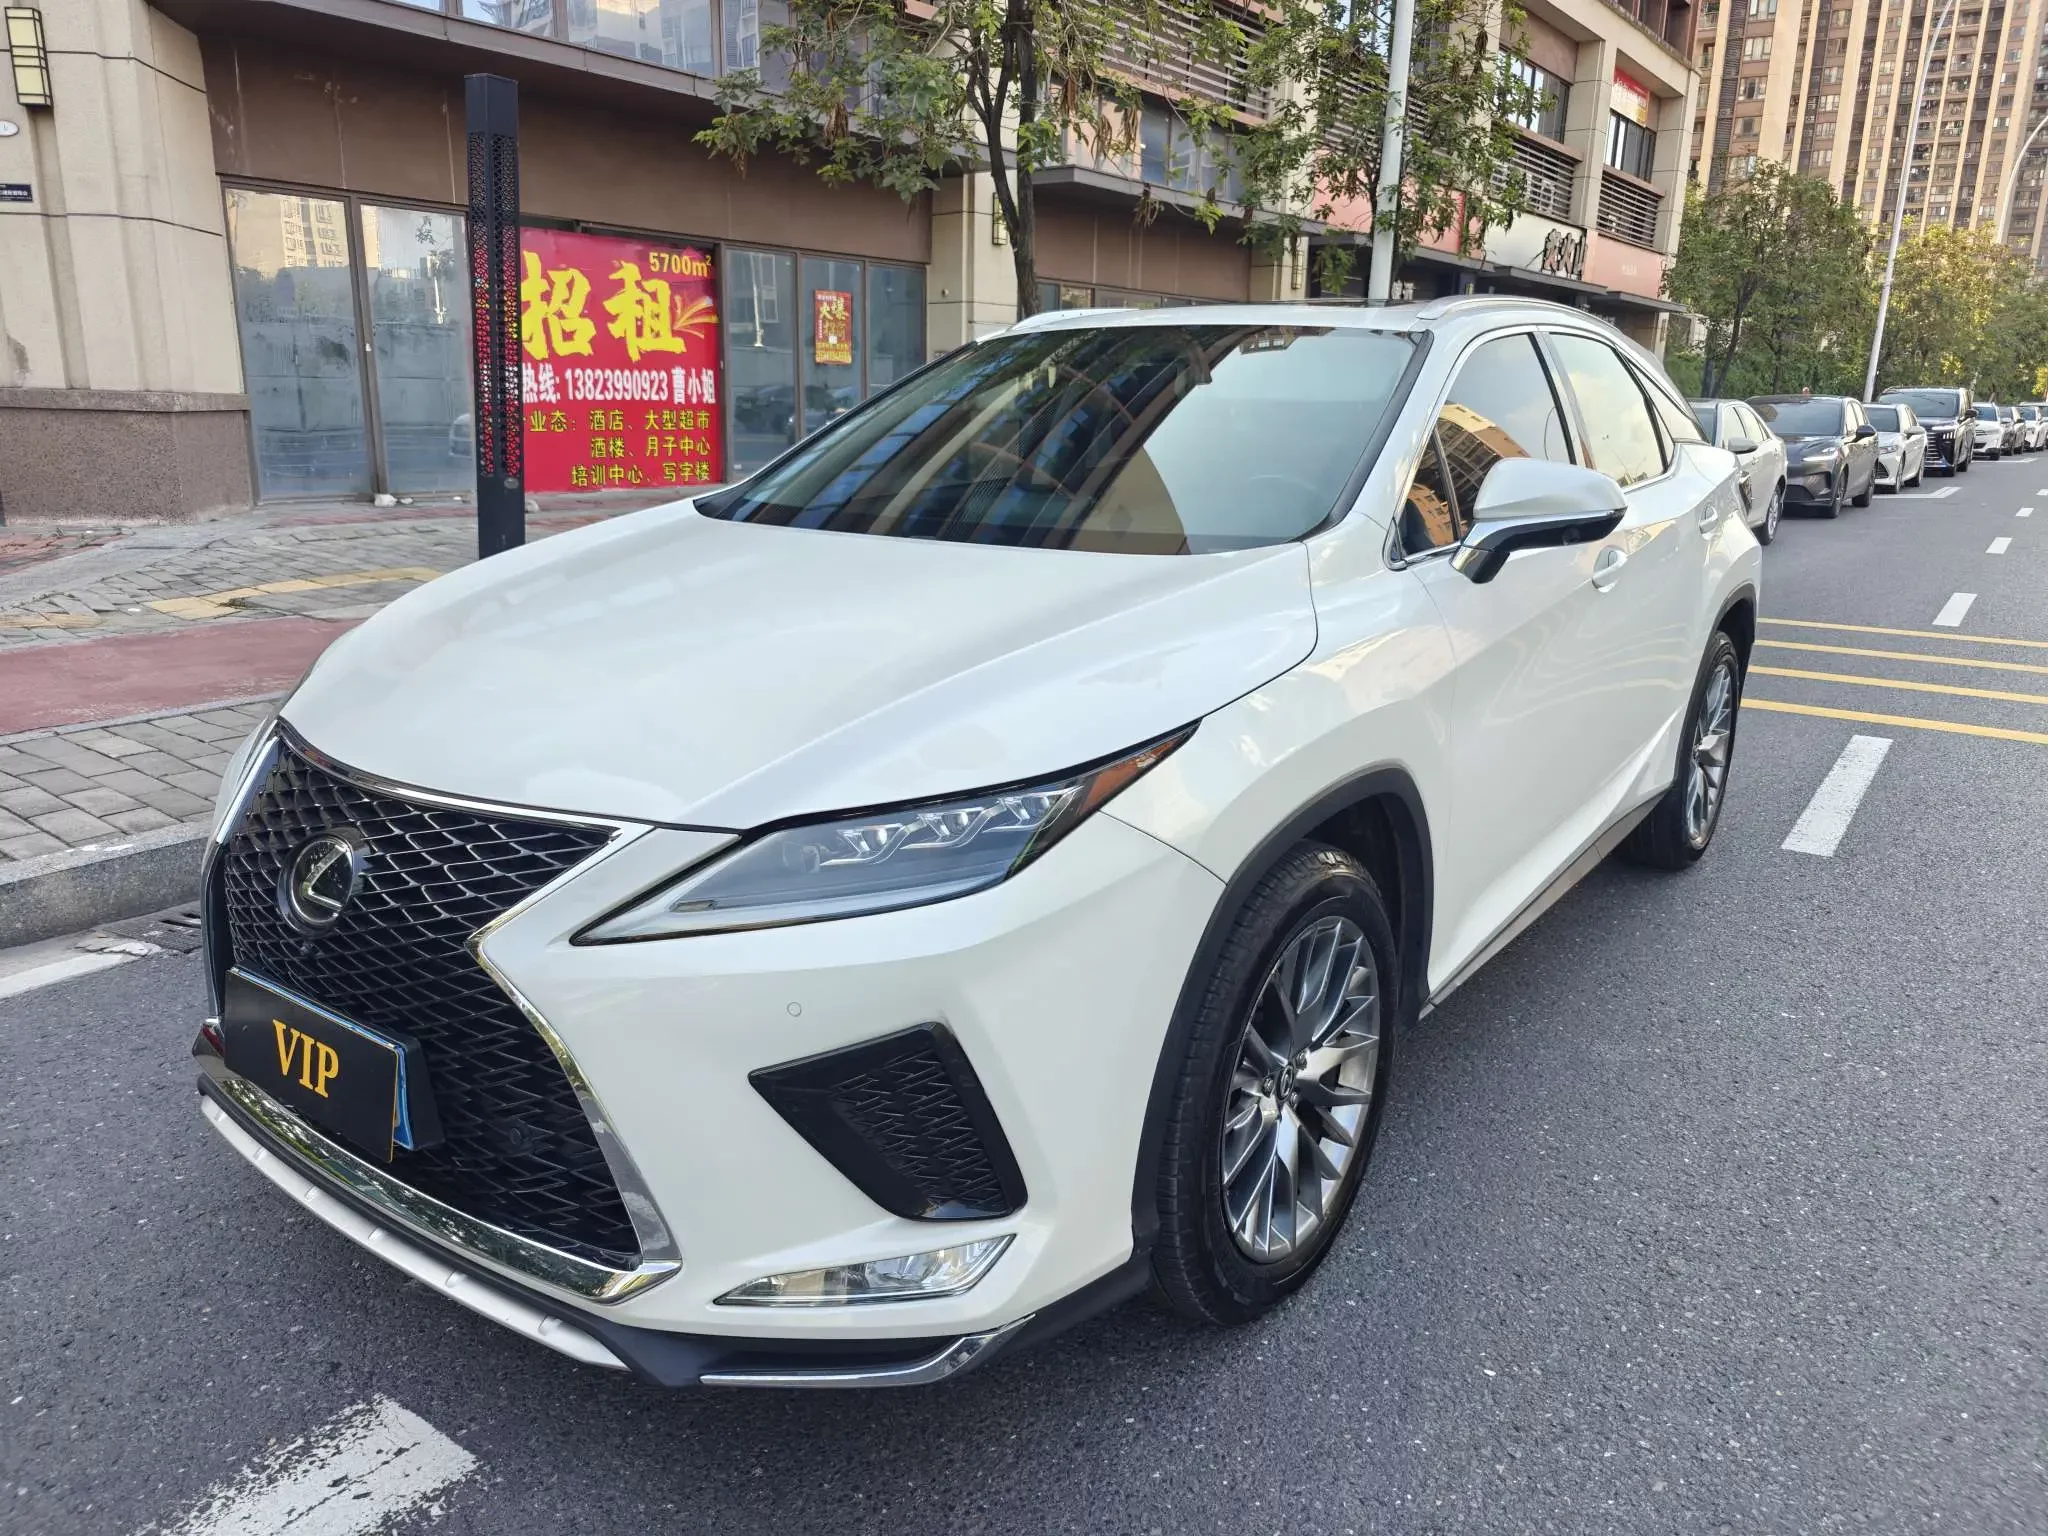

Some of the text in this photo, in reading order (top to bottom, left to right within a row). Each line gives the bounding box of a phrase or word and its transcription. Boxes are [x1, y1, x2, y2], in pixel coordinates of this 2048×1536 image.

[521, 250, 687, 363] 招租
[564, 368, 669, 401] 13823990923
[671, 367, 716, 404] 曹小姐
[590, 436, 711, 460] 酒楼、月子中心
[571, 461, 711, 488] 培训中心、写字楼
[272, 1018, 340, 1098] VIP
